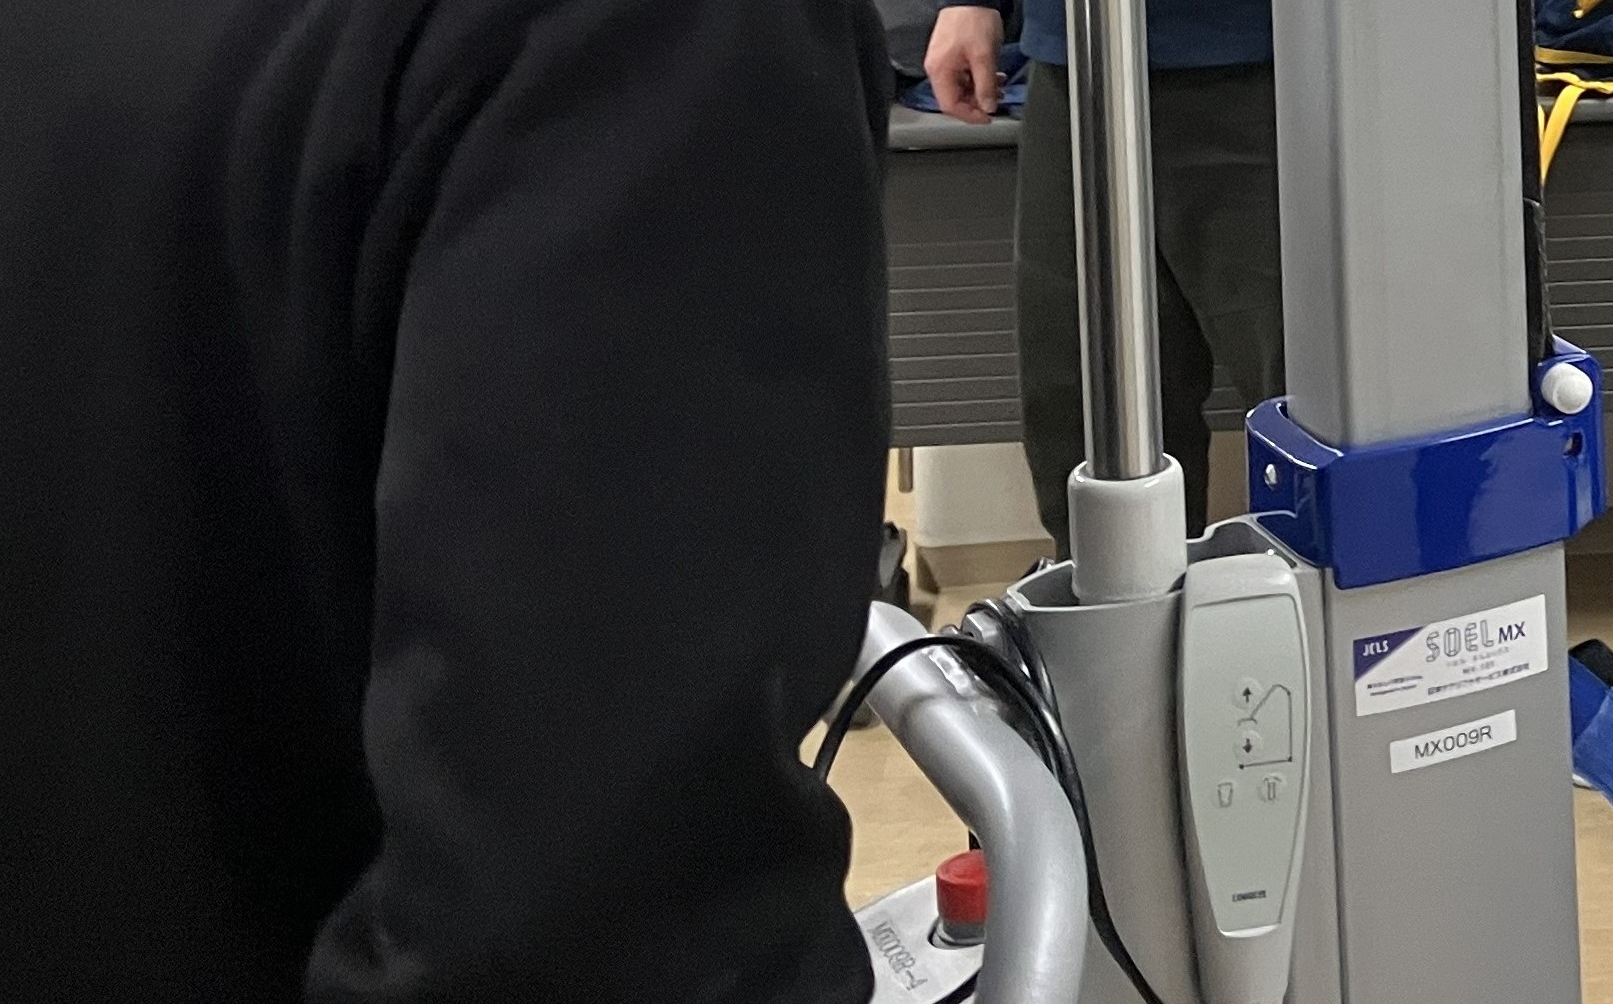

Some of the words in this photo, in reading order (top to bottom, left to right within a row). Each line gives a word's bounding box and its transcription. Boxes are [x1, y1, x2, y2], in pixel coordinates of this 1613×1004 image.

[1425, 619, 1494, 663] SOEL
[1498, 621, 1526, 645] MX
[1414, 724, 1493, 760] MX009R
